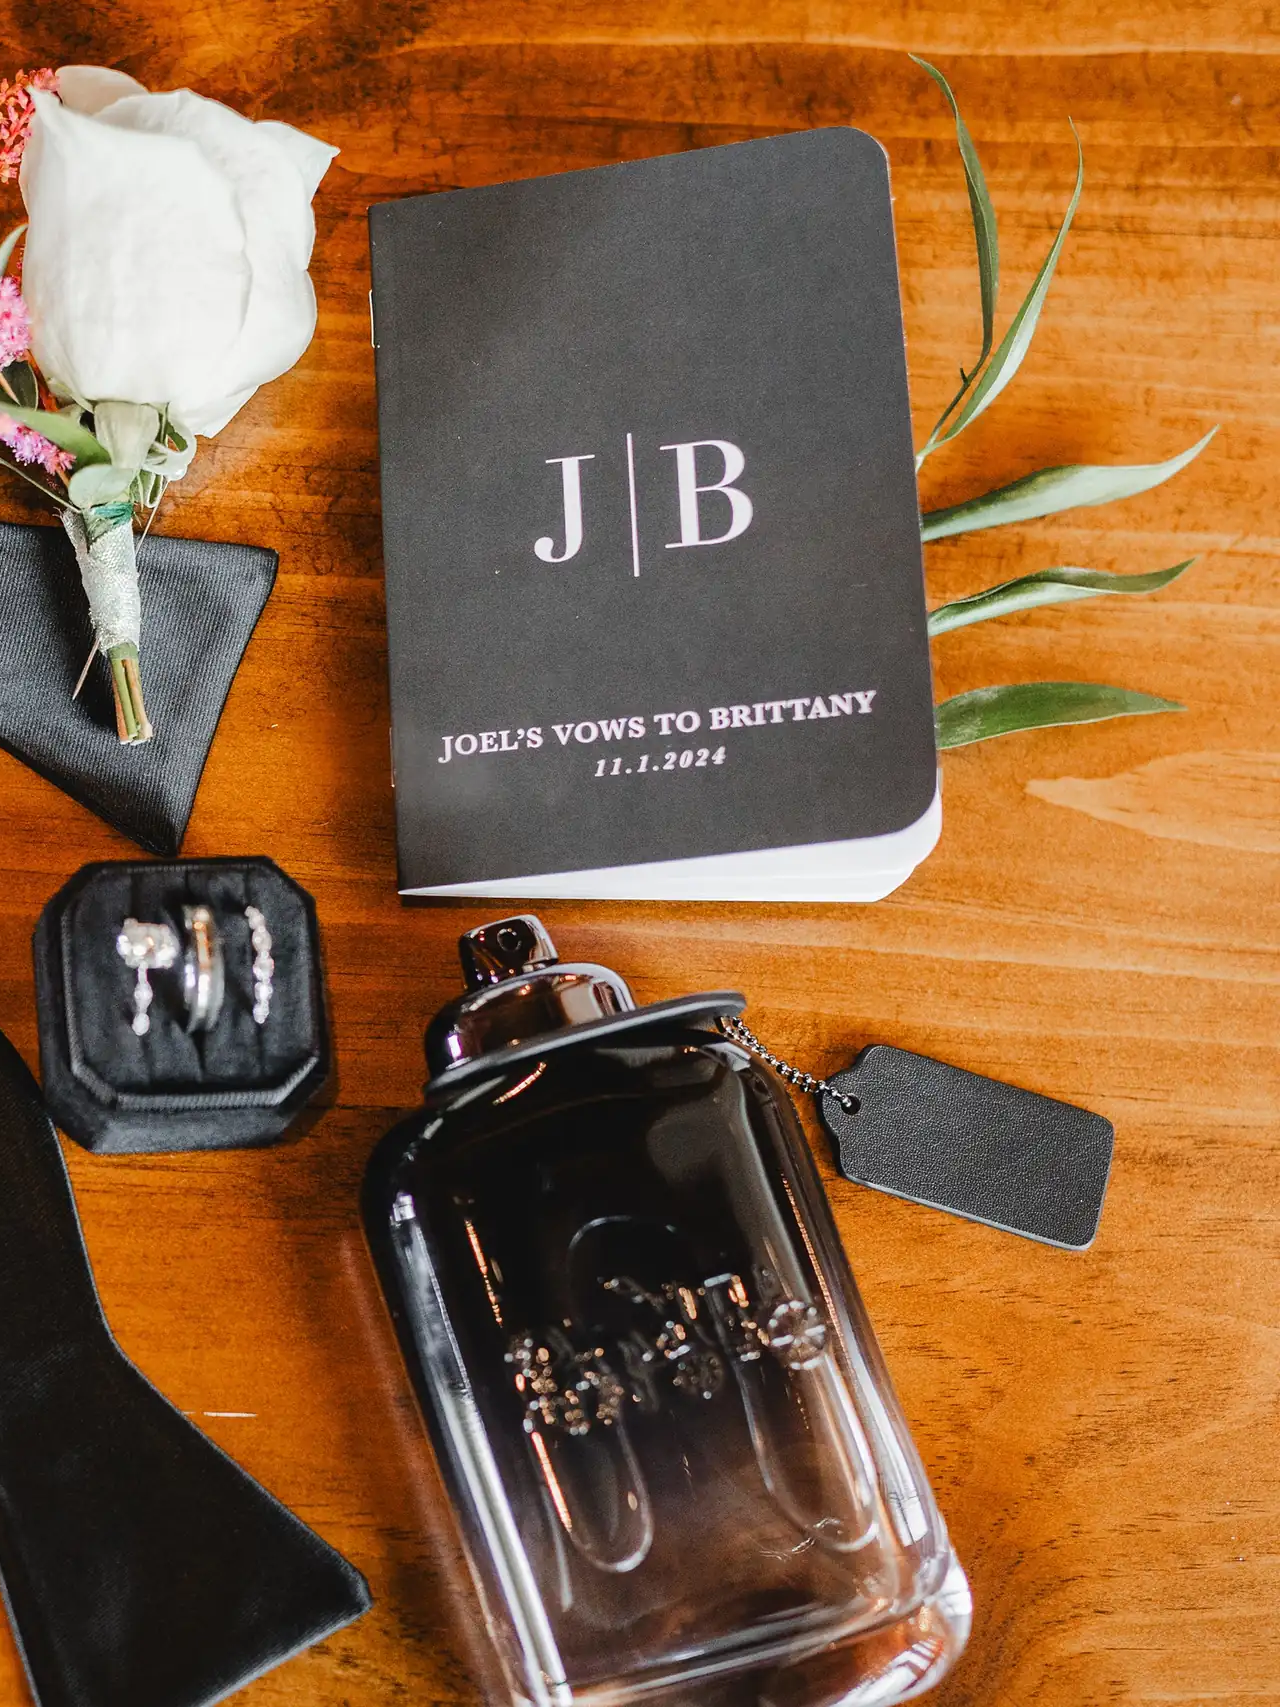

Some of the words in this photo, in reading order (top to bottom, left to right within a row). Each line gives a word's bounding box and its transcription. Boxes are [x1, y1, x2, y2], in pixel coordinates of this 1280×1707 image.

[437, 726, 544, 764] JOEL'S
[550, 716, 646, 746] VOWS
[653, 710, 701, 736] TO
[708, 690, 877, 731] BRITTANY
[593, 745, 727, 778] 11.1.2024
